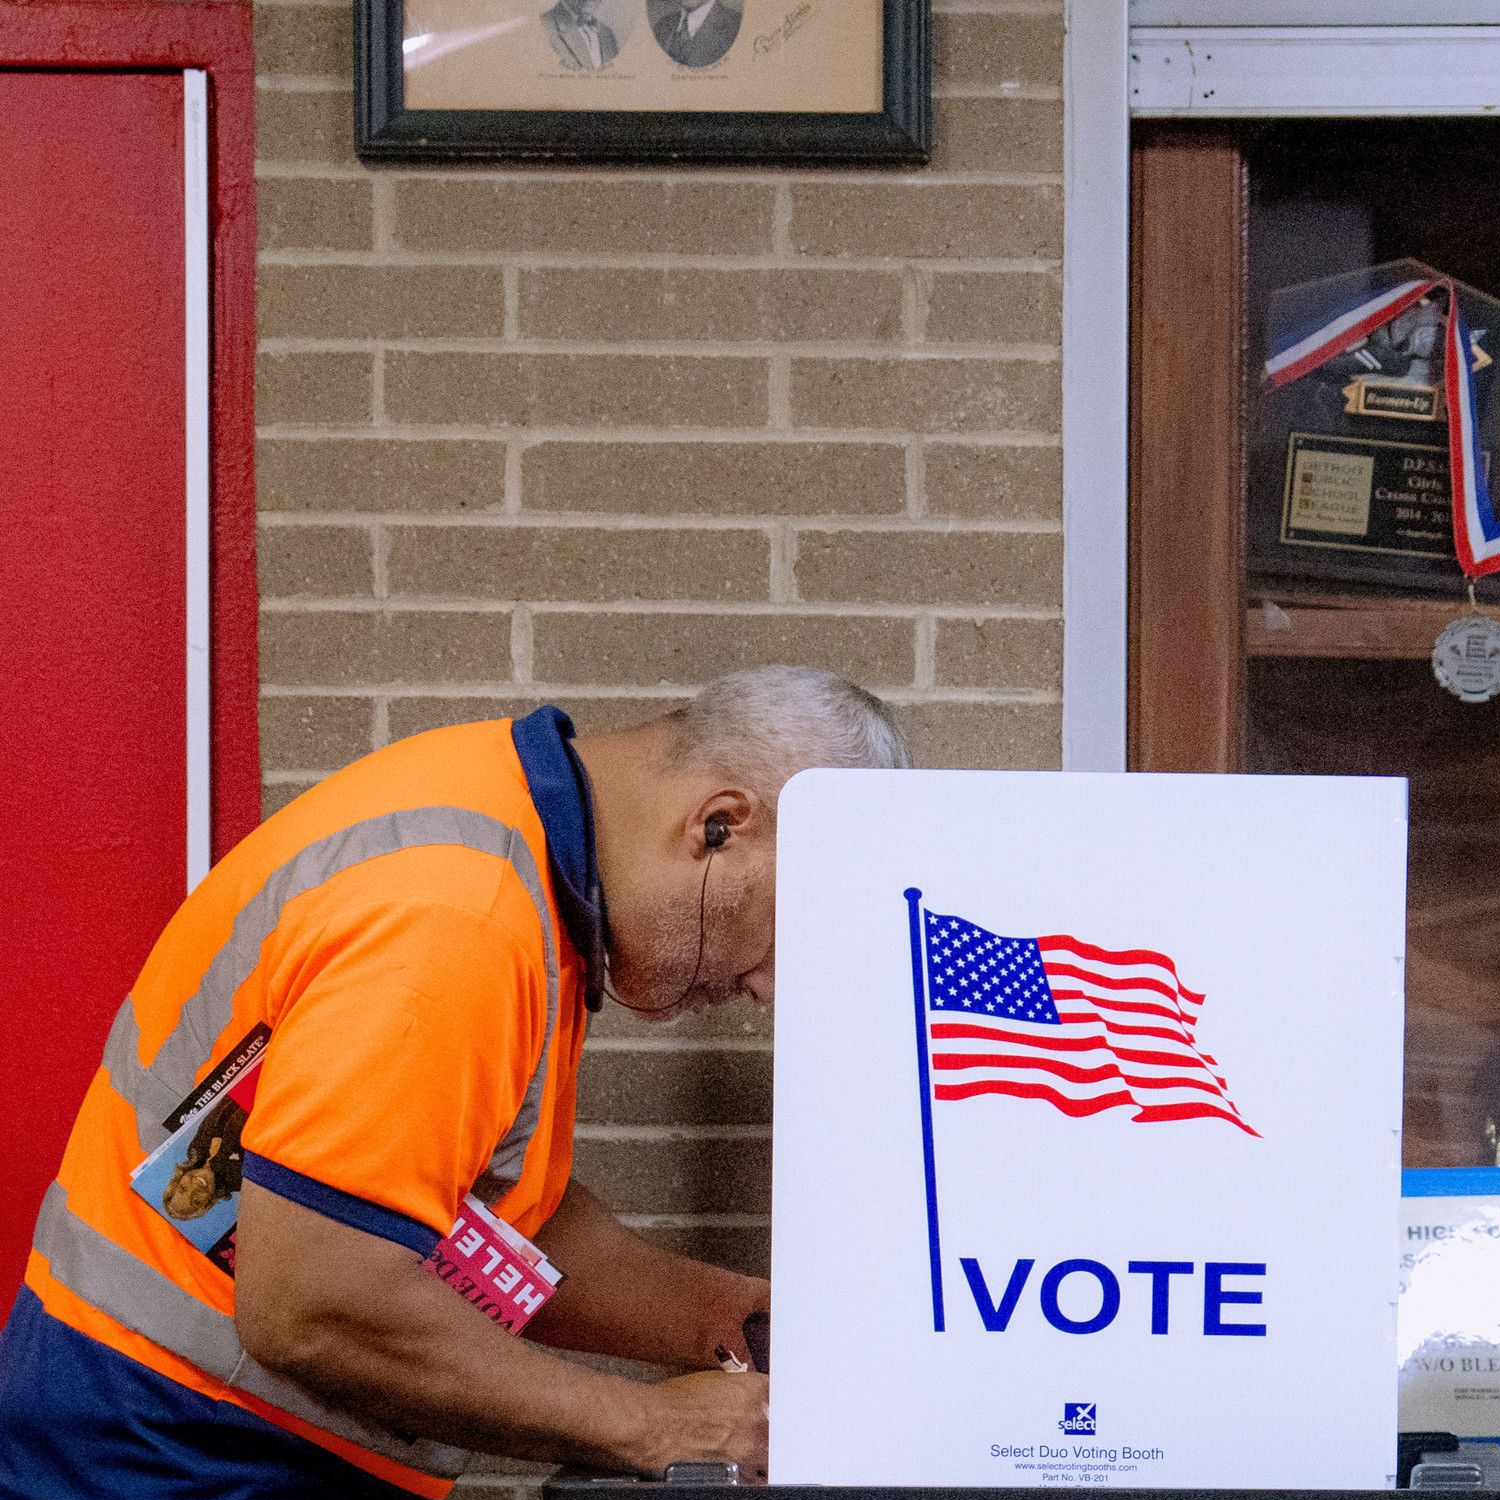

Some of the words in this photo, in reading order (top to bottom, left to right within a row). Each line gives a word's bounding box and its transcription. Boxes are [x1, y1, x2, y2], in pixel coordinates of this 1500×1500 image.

[195, 1089, 216, 1108] THE
[211, 1062, 241, 1090] BLACK
[960, 1258, 1267, 1337] VOTE
[1058, 1417, 1097, 1431] select
[990, 1444, 1034, 1458] Select
[1039, 1445, 1068, 1459] Duo
[1072, 1446, 1117, 1462] Voting
[1122, 1446, 1164, 1460] Booth
[1014, 1462, 1138, 1473] www.selectvotingbooths.com
[1042, 1473, 1059, 1482] Part
[1061, 1473, 1075, 1482] No.
[1078, 1474, 1109, 1483] VB-201
